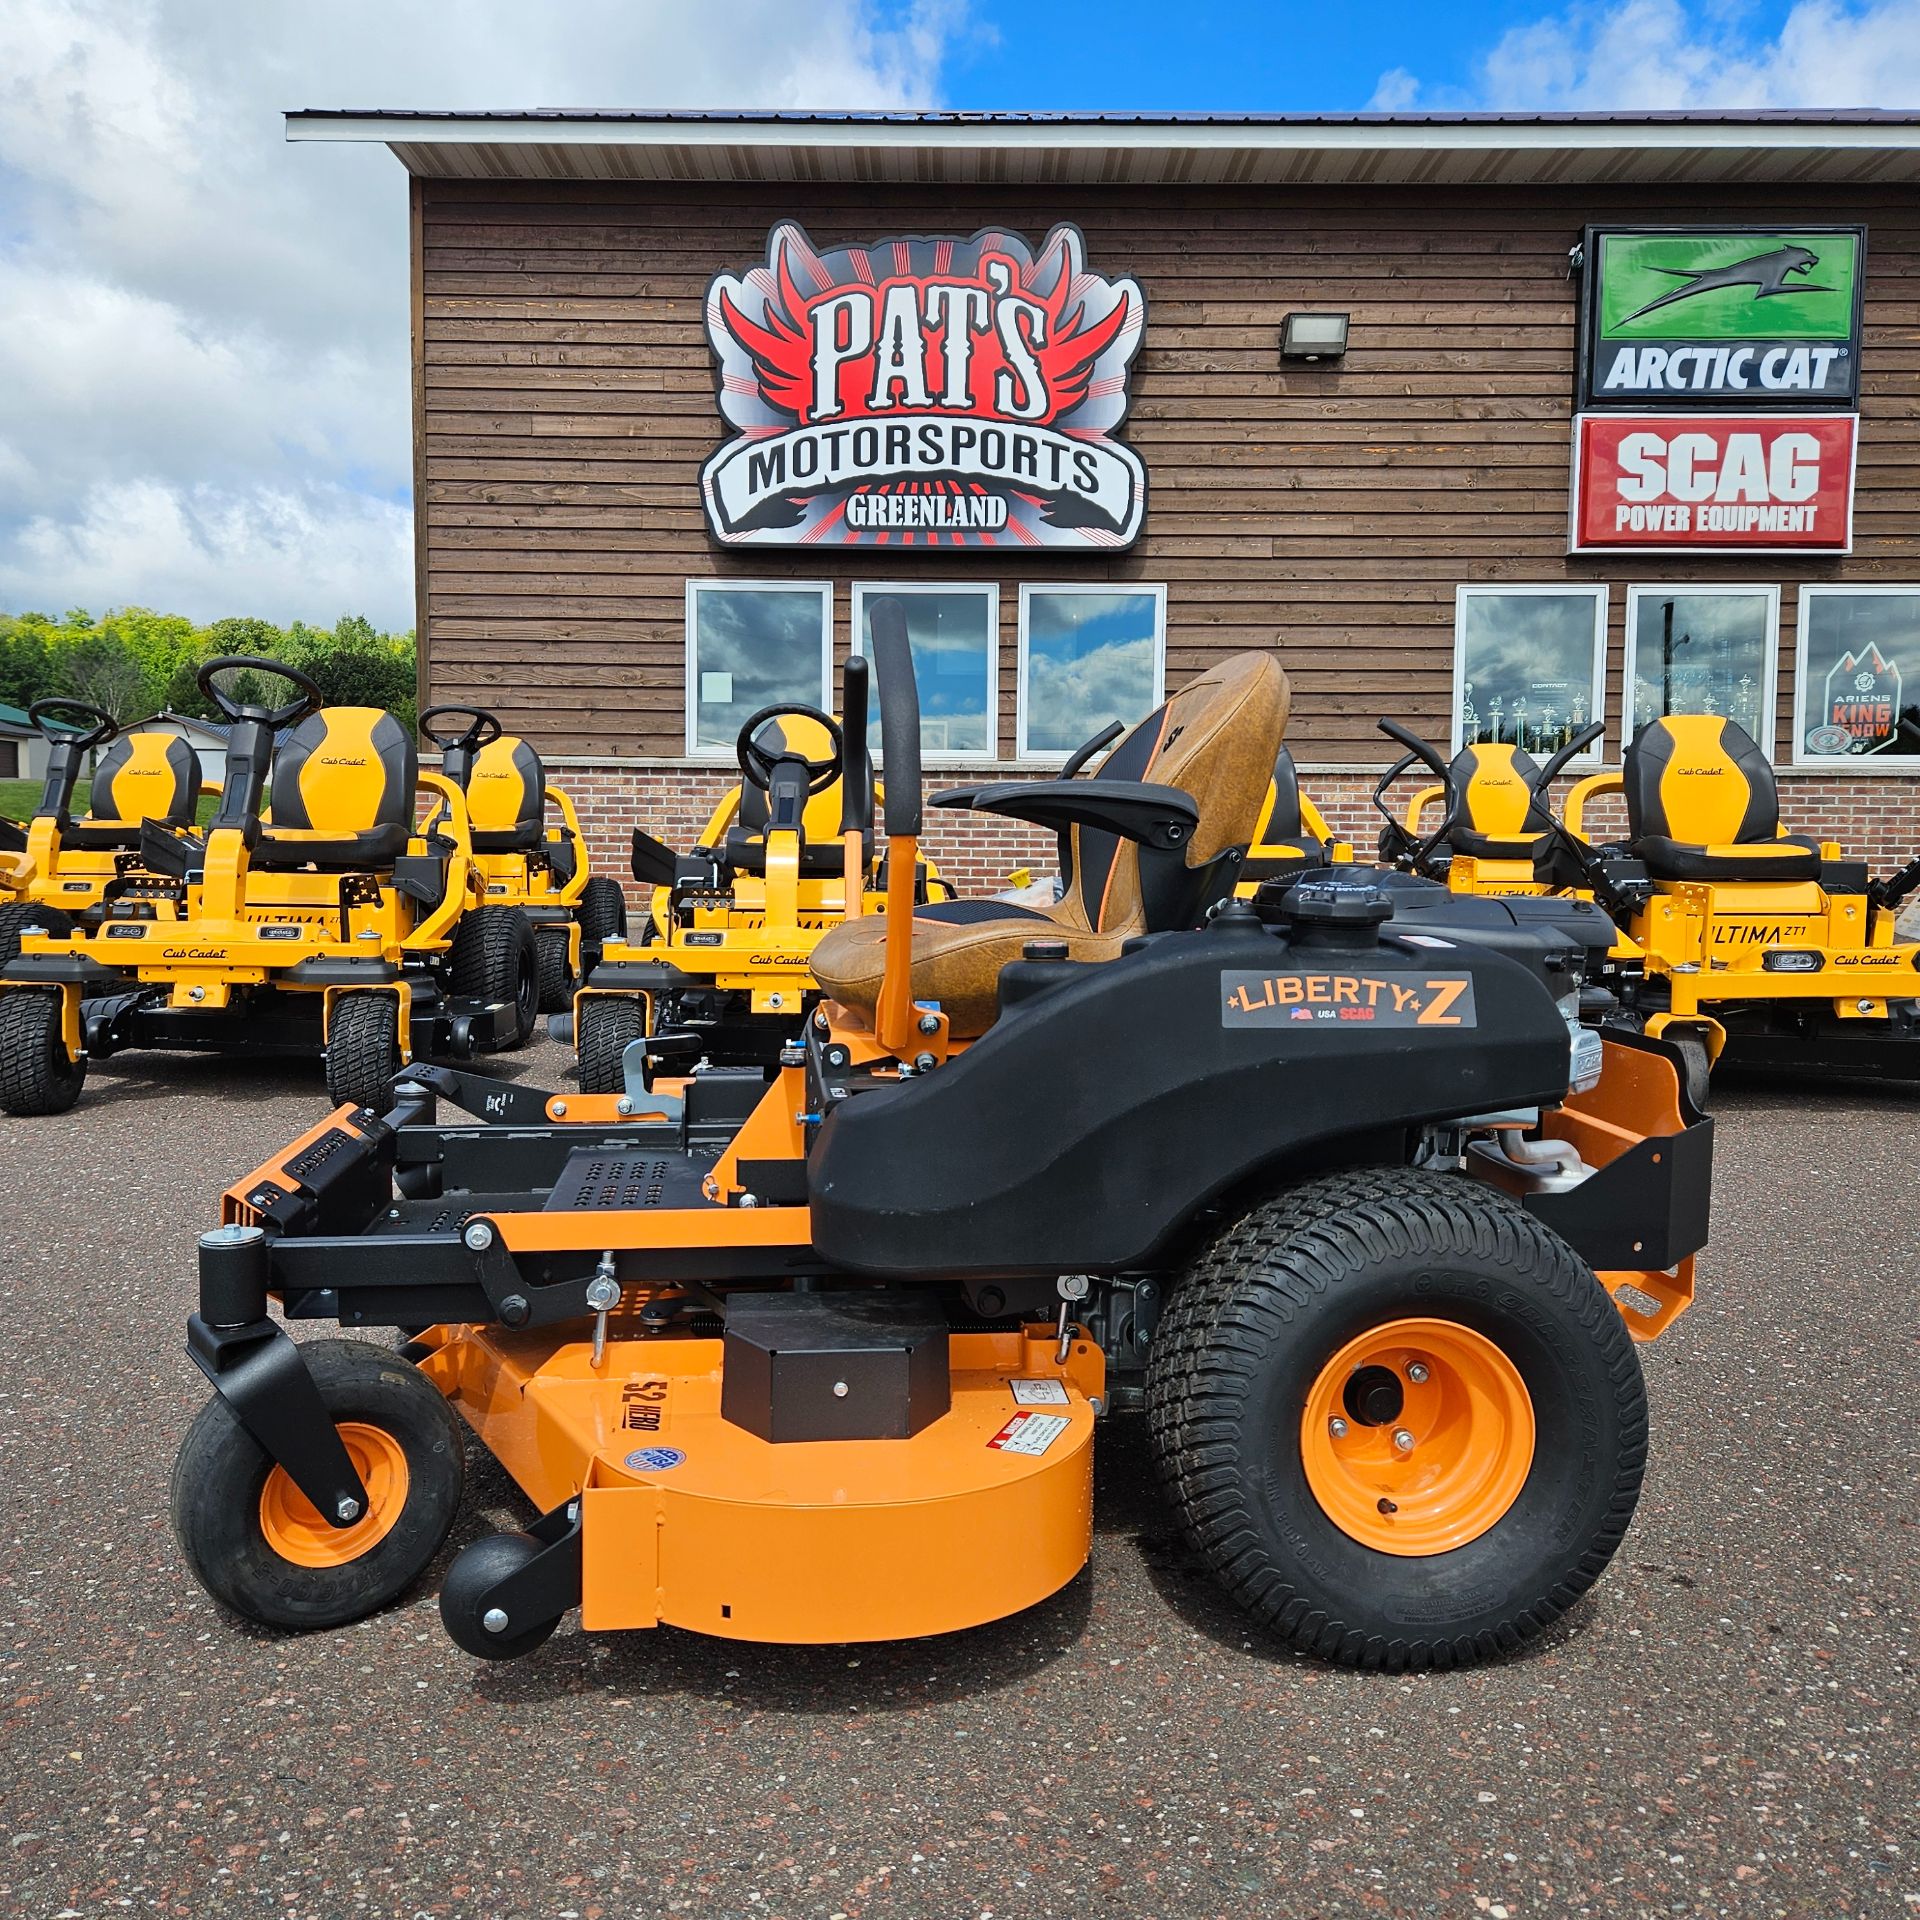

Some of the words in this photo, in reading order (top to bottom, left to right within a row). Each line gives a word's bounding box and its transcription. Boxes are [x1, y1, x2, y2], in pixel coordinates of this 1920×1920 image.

[808, 261, 1048, 420] PAT'S
[1602, 347, 1754, 389] ARCTIC
[747, 423, 1101, 496] MOTORSPORTS
[1616, 432, 1821, 502] SCAG
[846, 494, 1005, 528] GREENLAND
[1615, 504, 1691, 532] POWER
[1695, 504, 1818, 532] EQUIPMENT
[1834, 694, 1892, 703] ARIENS
[1832, 703, 1892, 724] KING
[320, 757, 338, 765] Cub
[338, 758, 367, 766] Cadet
[1677, 768, 1694, 776] Cub
[1695, 767, 1725, 776] Cadet
[1783, 926, 1807, 936] ZT1
[162, 948, 186, 958] Cub
[188, 948, 228, 959] Cadet
[749, 955, 772, 964] Cub
[1834, 955, 1858, 965] Cub
[1860, 955, 1902, 965] Cadet
[1237, 975, 1416, 1013] LIBERTY
[1417, 980, 1468, 1025] Z
[1317, 1009, 1337, 1019] USA
[1339, 1007, 1375, 1020] SCAG
[621, 1381, 668, 1403] 52
[628, 1404, 662, 1432] HERO
